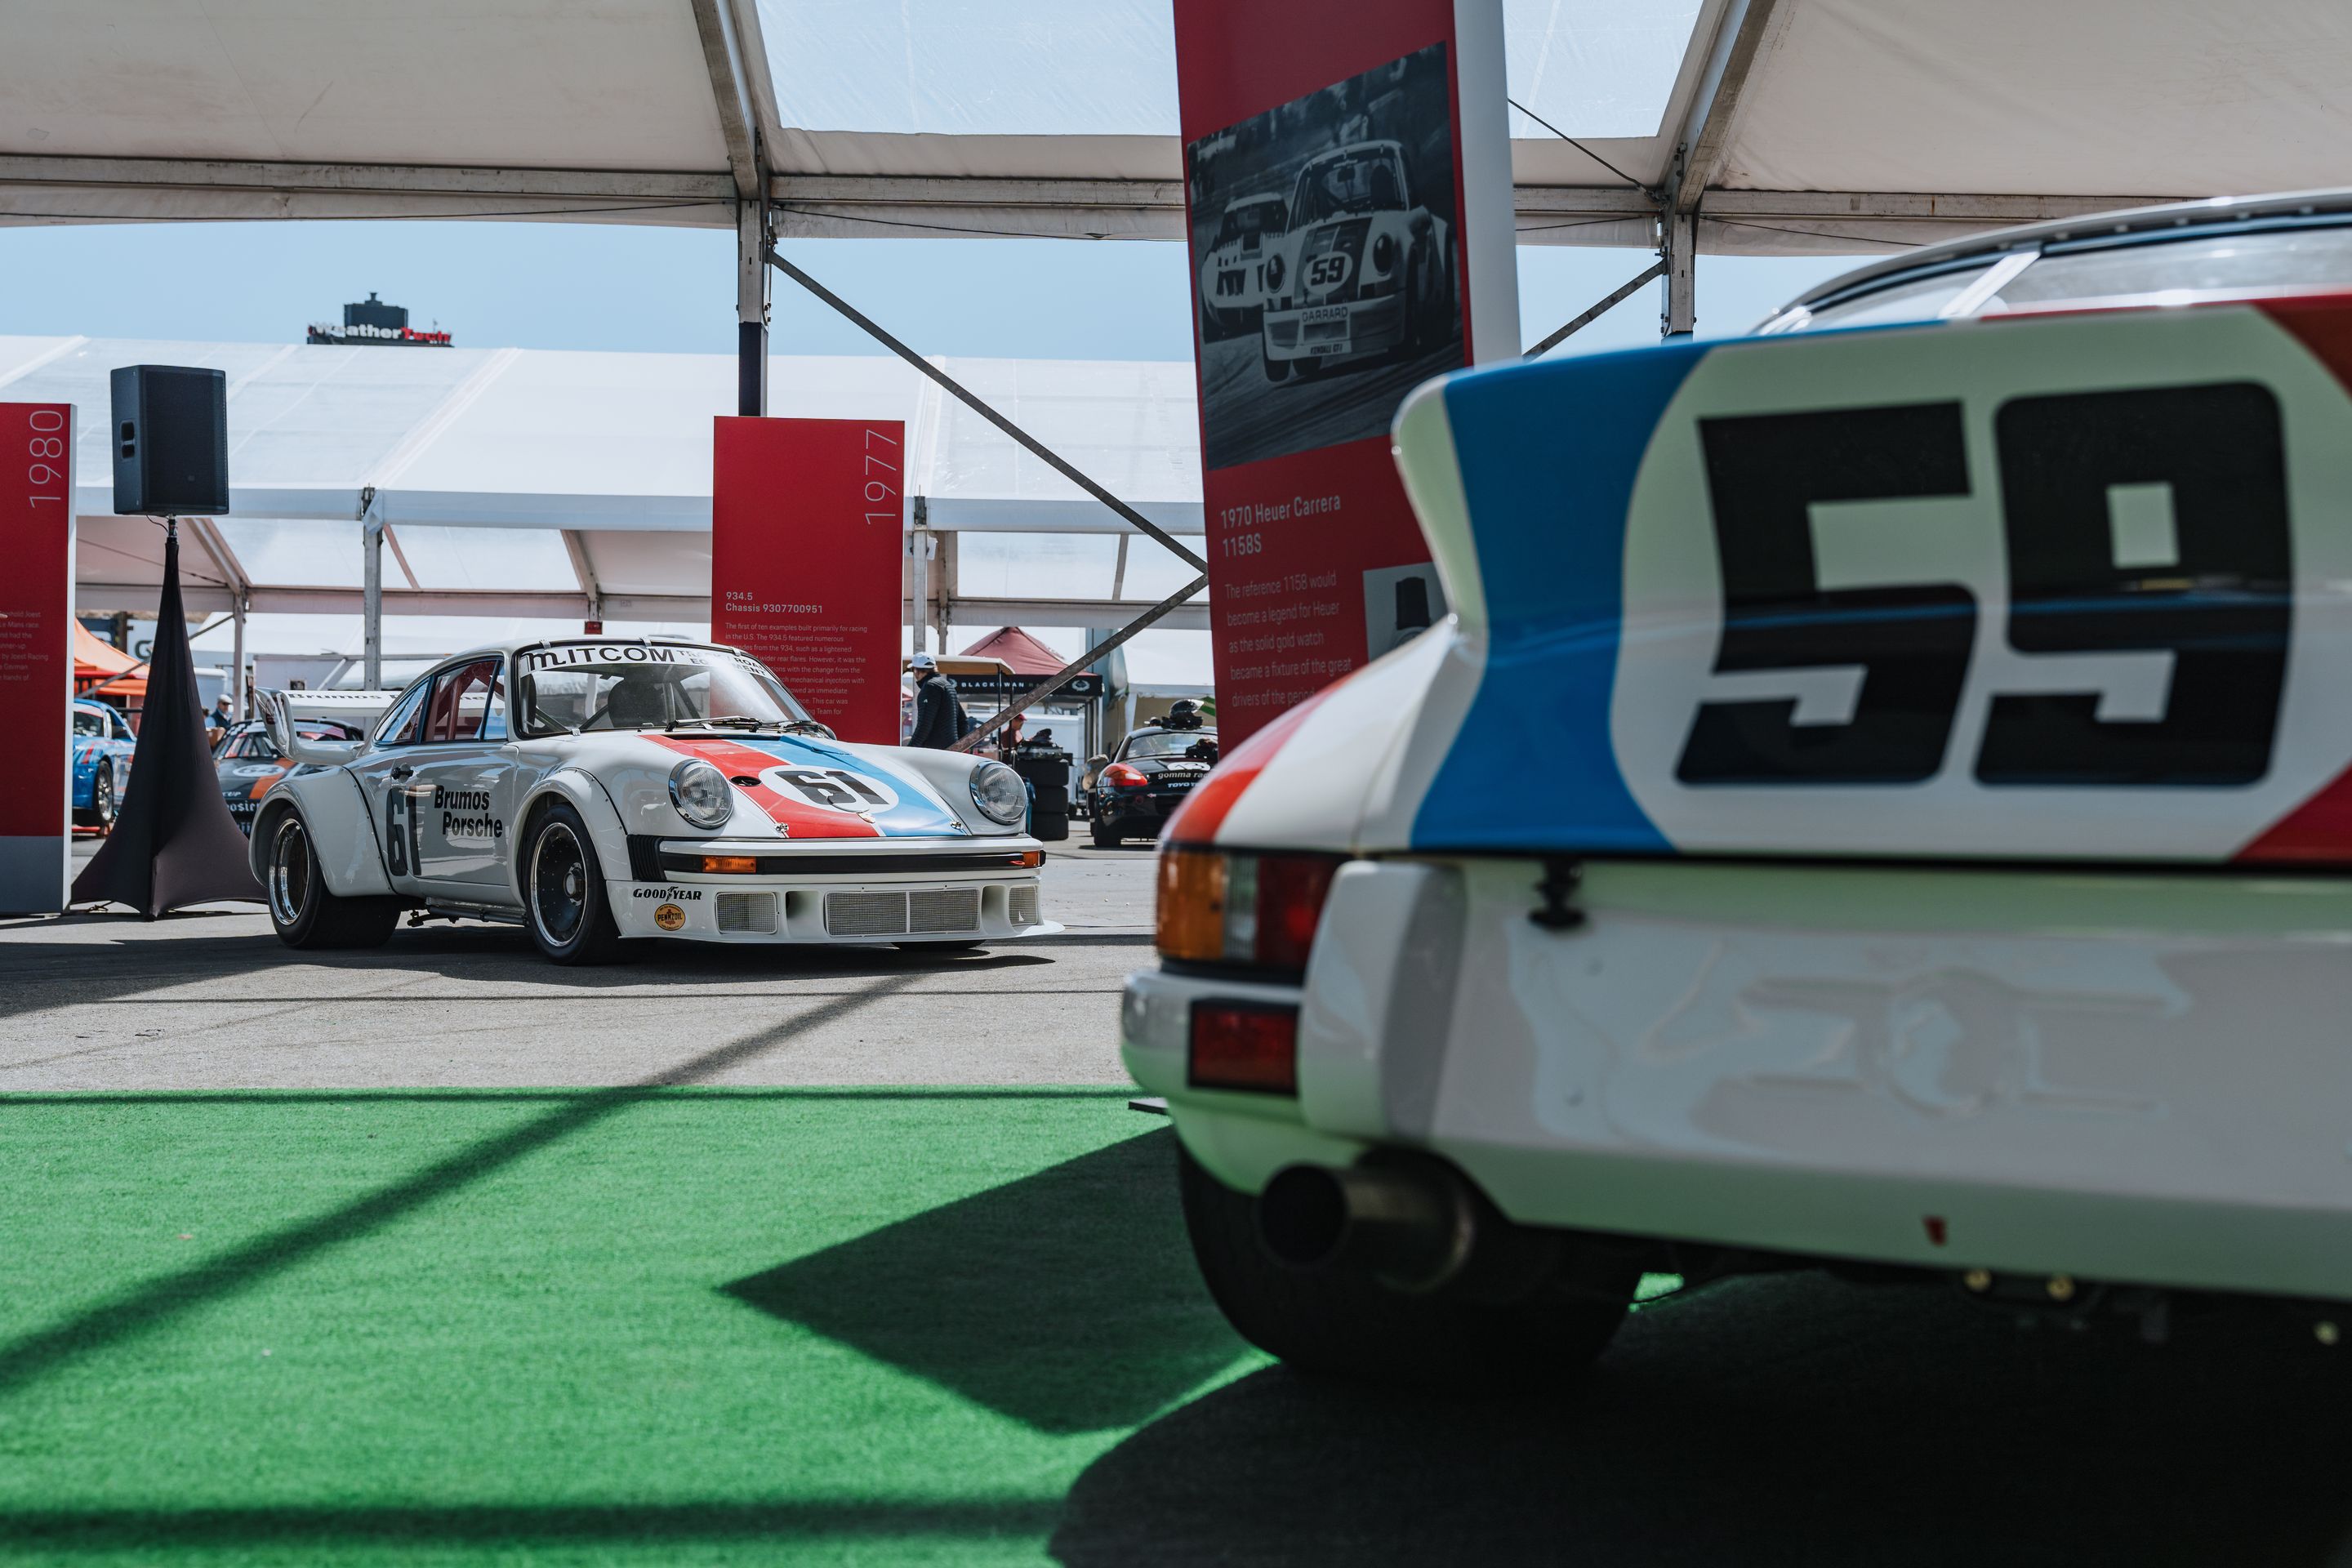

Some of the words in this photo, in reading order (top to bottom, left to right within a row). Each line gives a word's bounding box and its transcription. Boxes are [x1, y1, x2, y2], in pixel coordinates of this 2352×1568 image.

[1310, 256, 1346, 286] 59
[1302, 306, 1348, 323] GARRARD
[314, 323, 451, 341] WeatherTech
[29, 410, 63, 508] 1980
[865, 429, 897, 525] 1977
[1221, 505, 1252, 530] 1970
[1255, 503, 1290, 523] Heuer
[1294, 495, 1341, 517] Carrera
[1223, 532, 1262, 557] 1158S
[1224, 584, 1241, 599] The
[1242, 581, 1281, 597] reference
[1283, 573, 1307, 591] 1158
[1308, 569, 1336, 588] would
[1673, 379, 2296, 786] 59
[726, 591, 753, 601] 934.5
[725, 603, 760, 612] Chassis
[763, 604, 822, 613] 9307700951
[1227, 611, 1260, 626] become
[1262, 611, 1267, 622] a
[1268, 604, 1298, 626] legend
[1298, 603, 1312, 618] for
[1313, 601, 1339, 617] Heuer
[769, 624, 797, 632] examples
[813, 624, 839, 633] primarily
[824, 645, 852, 654] lightened
[1228, 641, 1239, 653] as
[1240, 637, 1254, 652] the
[1255, 634, 1275, 651] solid
[1276, 631, 1295, 653] gold
[1296, 630, 1324, 647] watch
[760, 654, 777, 662] wider
[808, 656, 836, 664] However,
[812, 666, 834, 675] change
[1230, 665, 1263, 680] became
[1264, 666, 1270, 677] a
[1272, 661, 1299, 676] fixture
[1301, 658, 1310, 675] of
[1311, 658, 1326, 674] the
[1328, 657, 1352, 677] great
[825, 677, 850, 685] injection
[1232, 692, 1260, 707] drivers
[1261, 689, 1270, 706] of
[1272, 688, 1285, 705] the
[773, 770, 889, 805] 61
[1158, 772, 1192, 780] gomma
[434, 785, 490, 811] Brumos
[386, 786, 421, 877] 61
[443, 811, 503, 838] Porsche
[657, 912, 683, 921] PENNZOIL
